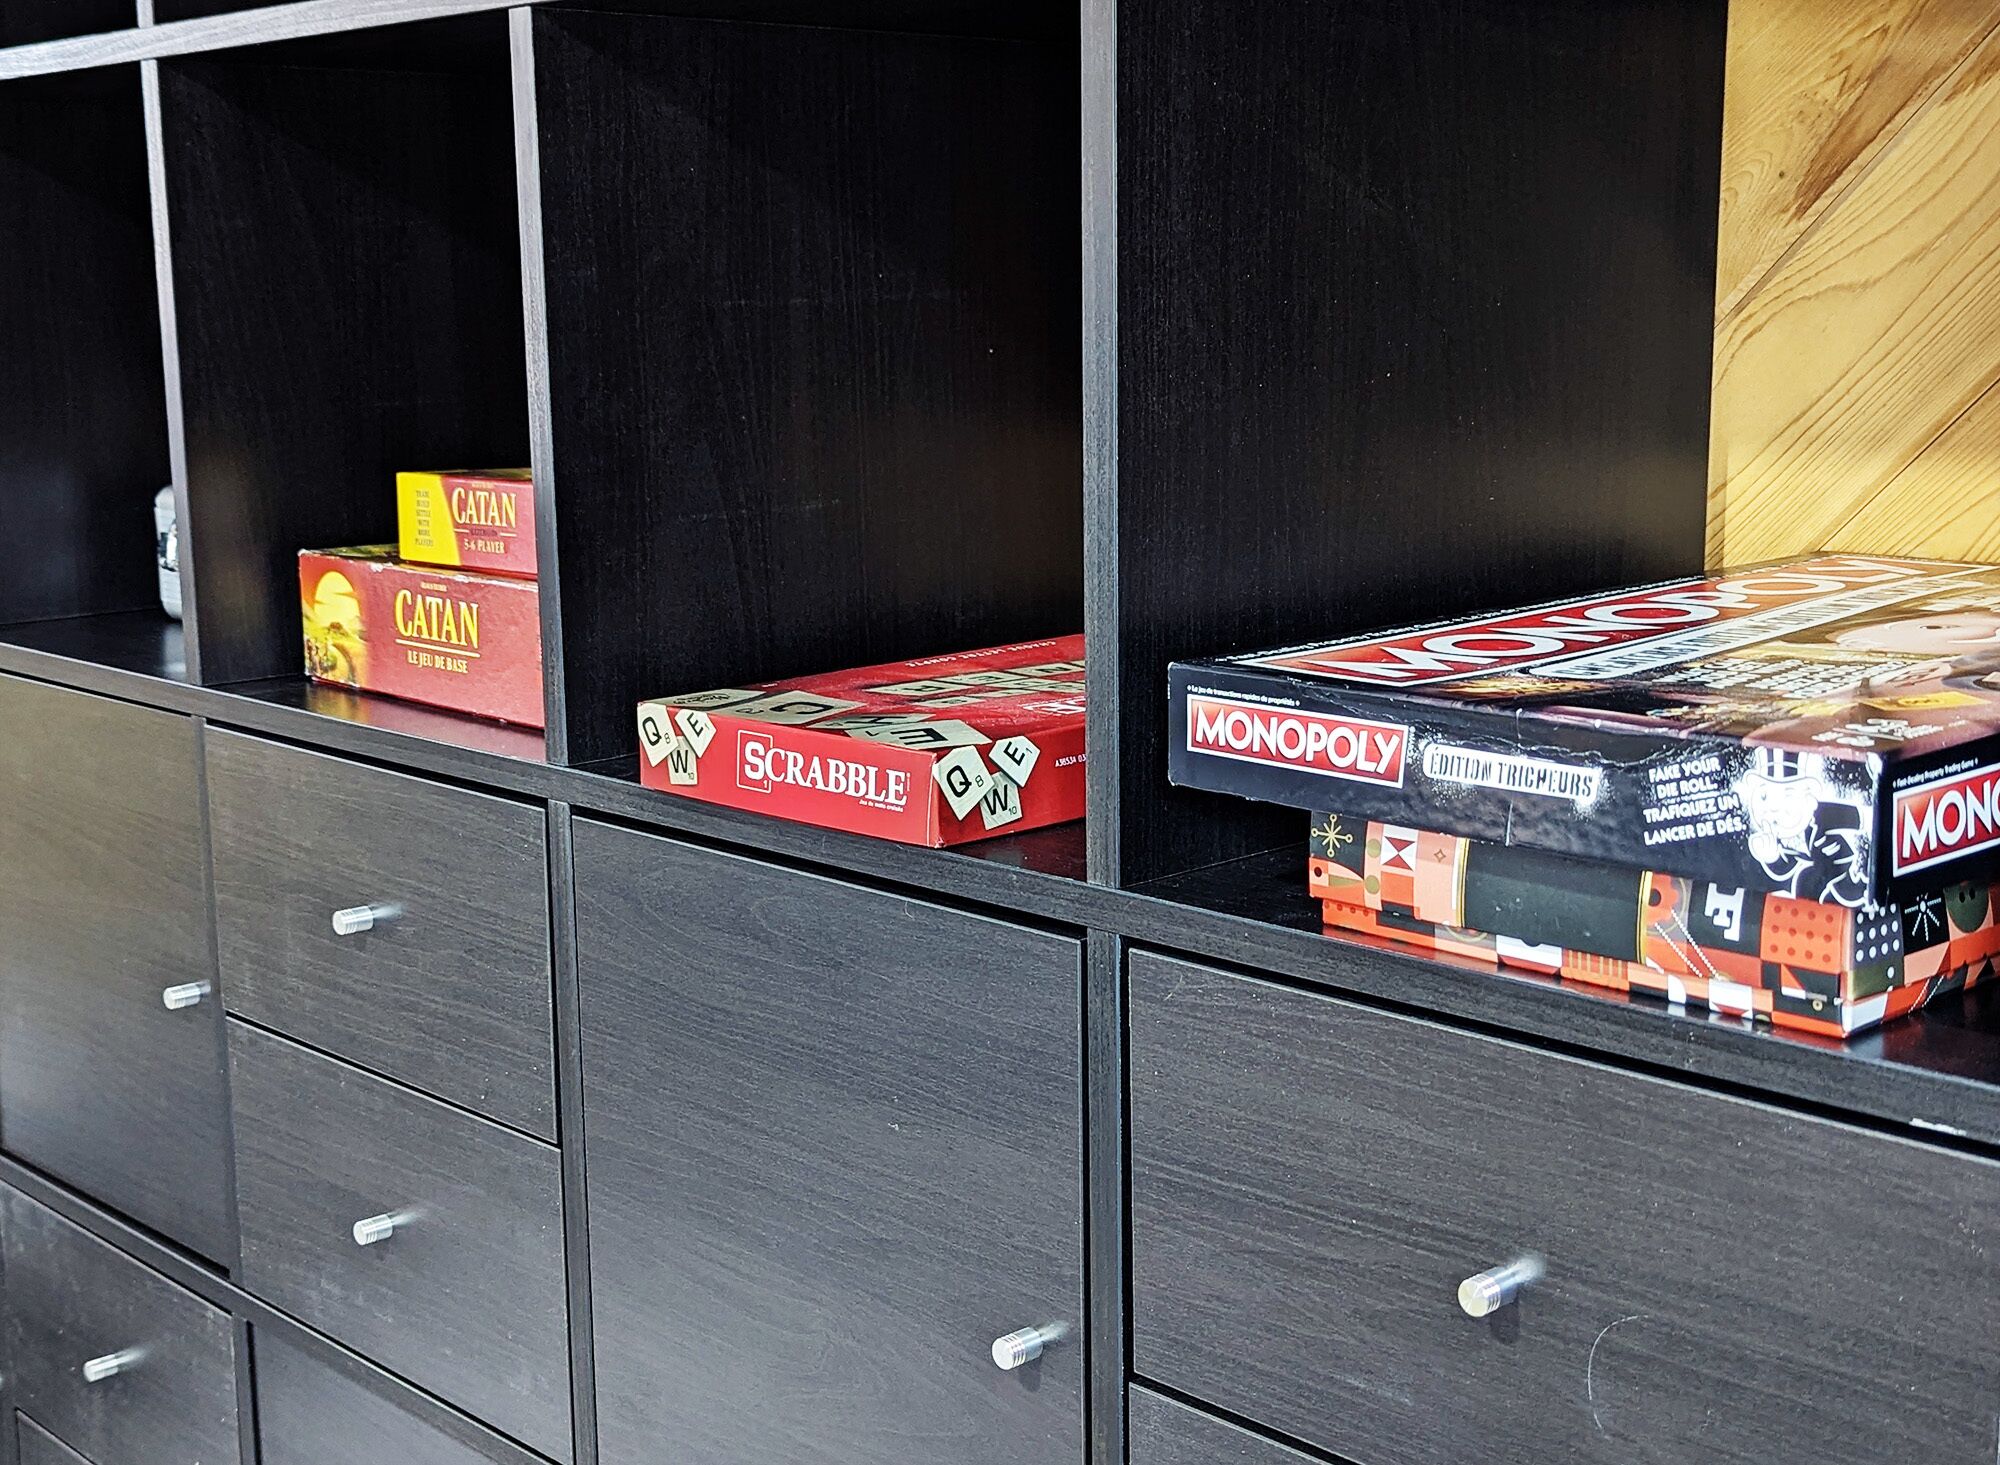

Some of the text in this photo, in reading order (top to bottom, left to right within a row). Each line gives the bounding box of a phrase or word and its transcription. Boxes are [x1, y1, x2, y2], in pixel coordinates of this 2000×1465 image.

[452, 487, 517, 528] CATAN
[478, 540, 505, 555] PLAYER
[395, 588, 479, 649] CATAN
[1300, 560, 1928, 679] MONOPOLY
[408, 650, 468, 674] LE JEU DE BASE
[642, 716, 671, 746] Q 8
[686, 712, 703, 737] E
[890, 727, 948, 746] E
[1195, 705, 1400, 774] MONOPOLY
[670, 749, 688, 774] W
[1003, 741, 1026, 767] E
[744, 740, 907, 806] SCRABBLE
[946, 764, 985, 798] Q 8
[1430, 746, 1593, 798] ÉDITION TRICHEURS
[1648, 757, 1721, 783] FAKE YOUR
[984, 784, 1018, 816] W 10
[1657, 775, 1718, 799] DIE ROLL.
[1643, 793, 1740, 823] TRAFIQUEZ UN
[1643, 813, 1747, 846] LANCER DE DÉS.
